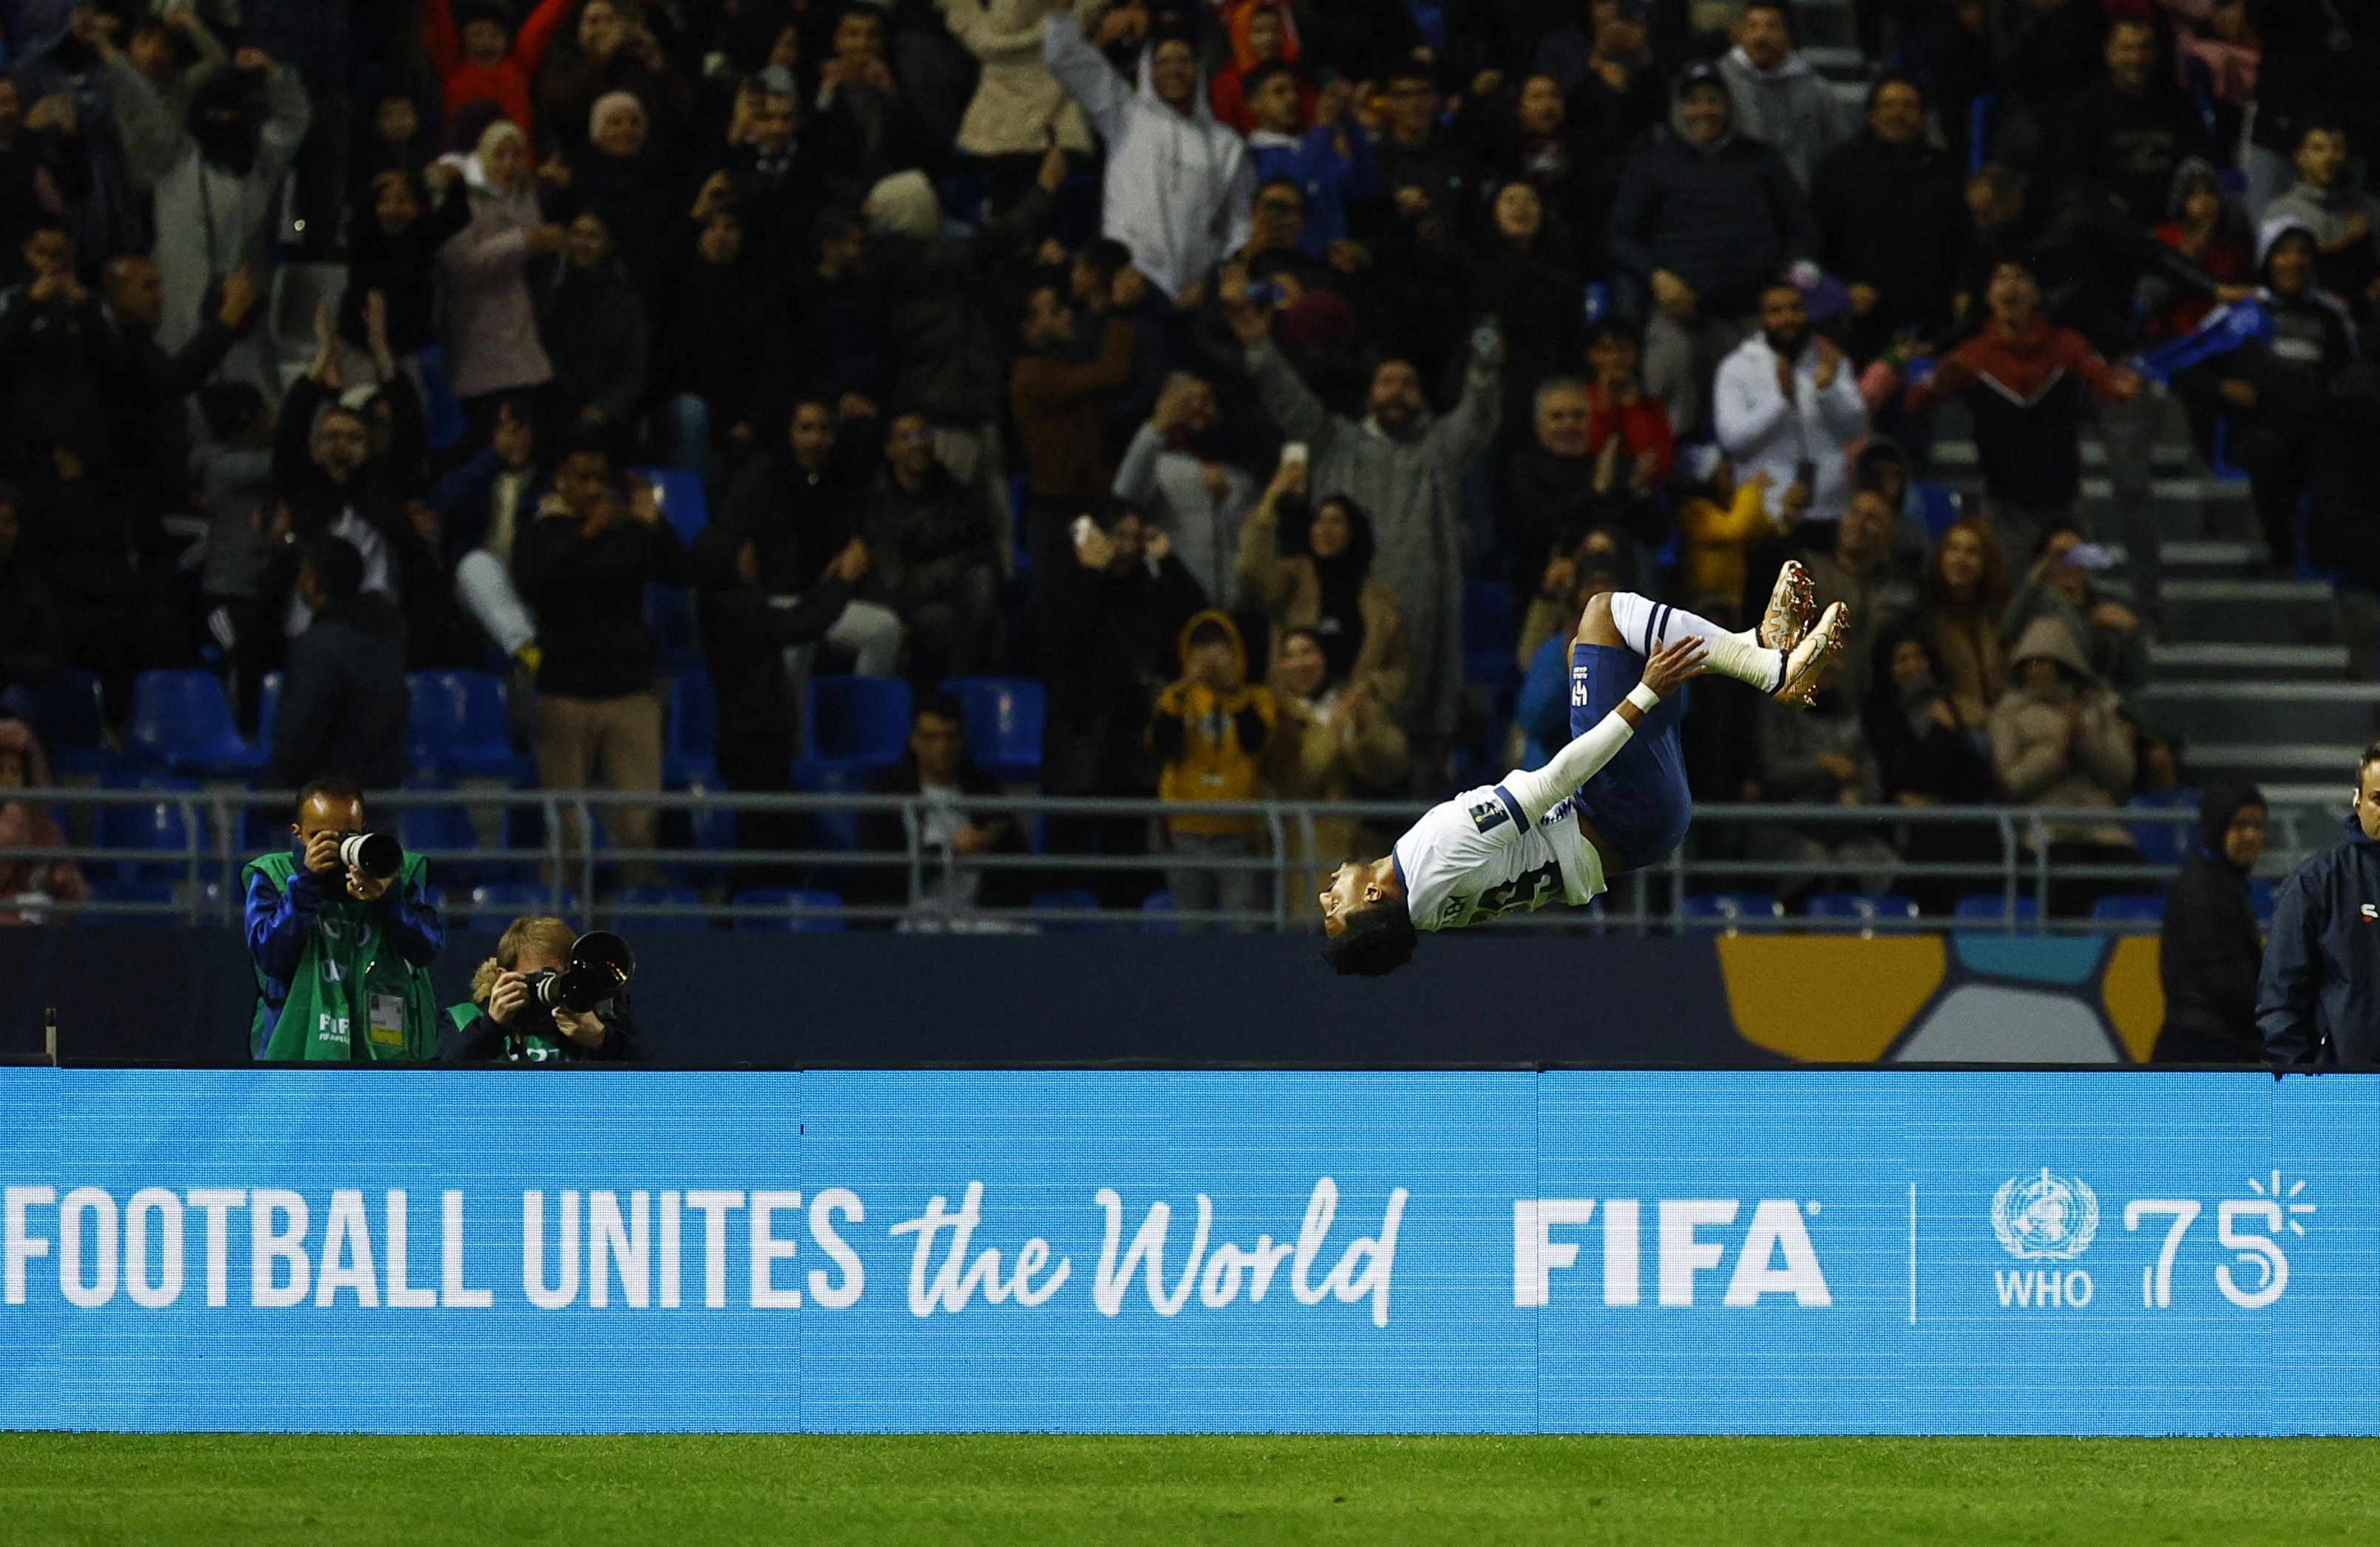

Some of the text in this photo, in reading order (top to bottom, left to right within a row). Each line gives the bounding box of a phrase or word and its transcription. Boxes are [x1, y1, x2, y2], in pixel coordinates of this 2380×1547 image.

[319, 1013, 350, 1034] FIF
[4, 1174, 1408, 1327] FOOTBALL UNITES the World
[1514, 1199, 1832, 1307] FIFA
[1996, 1271, 2092, 1307] WHO
[2125, 1200, 2288, 1308] 75
